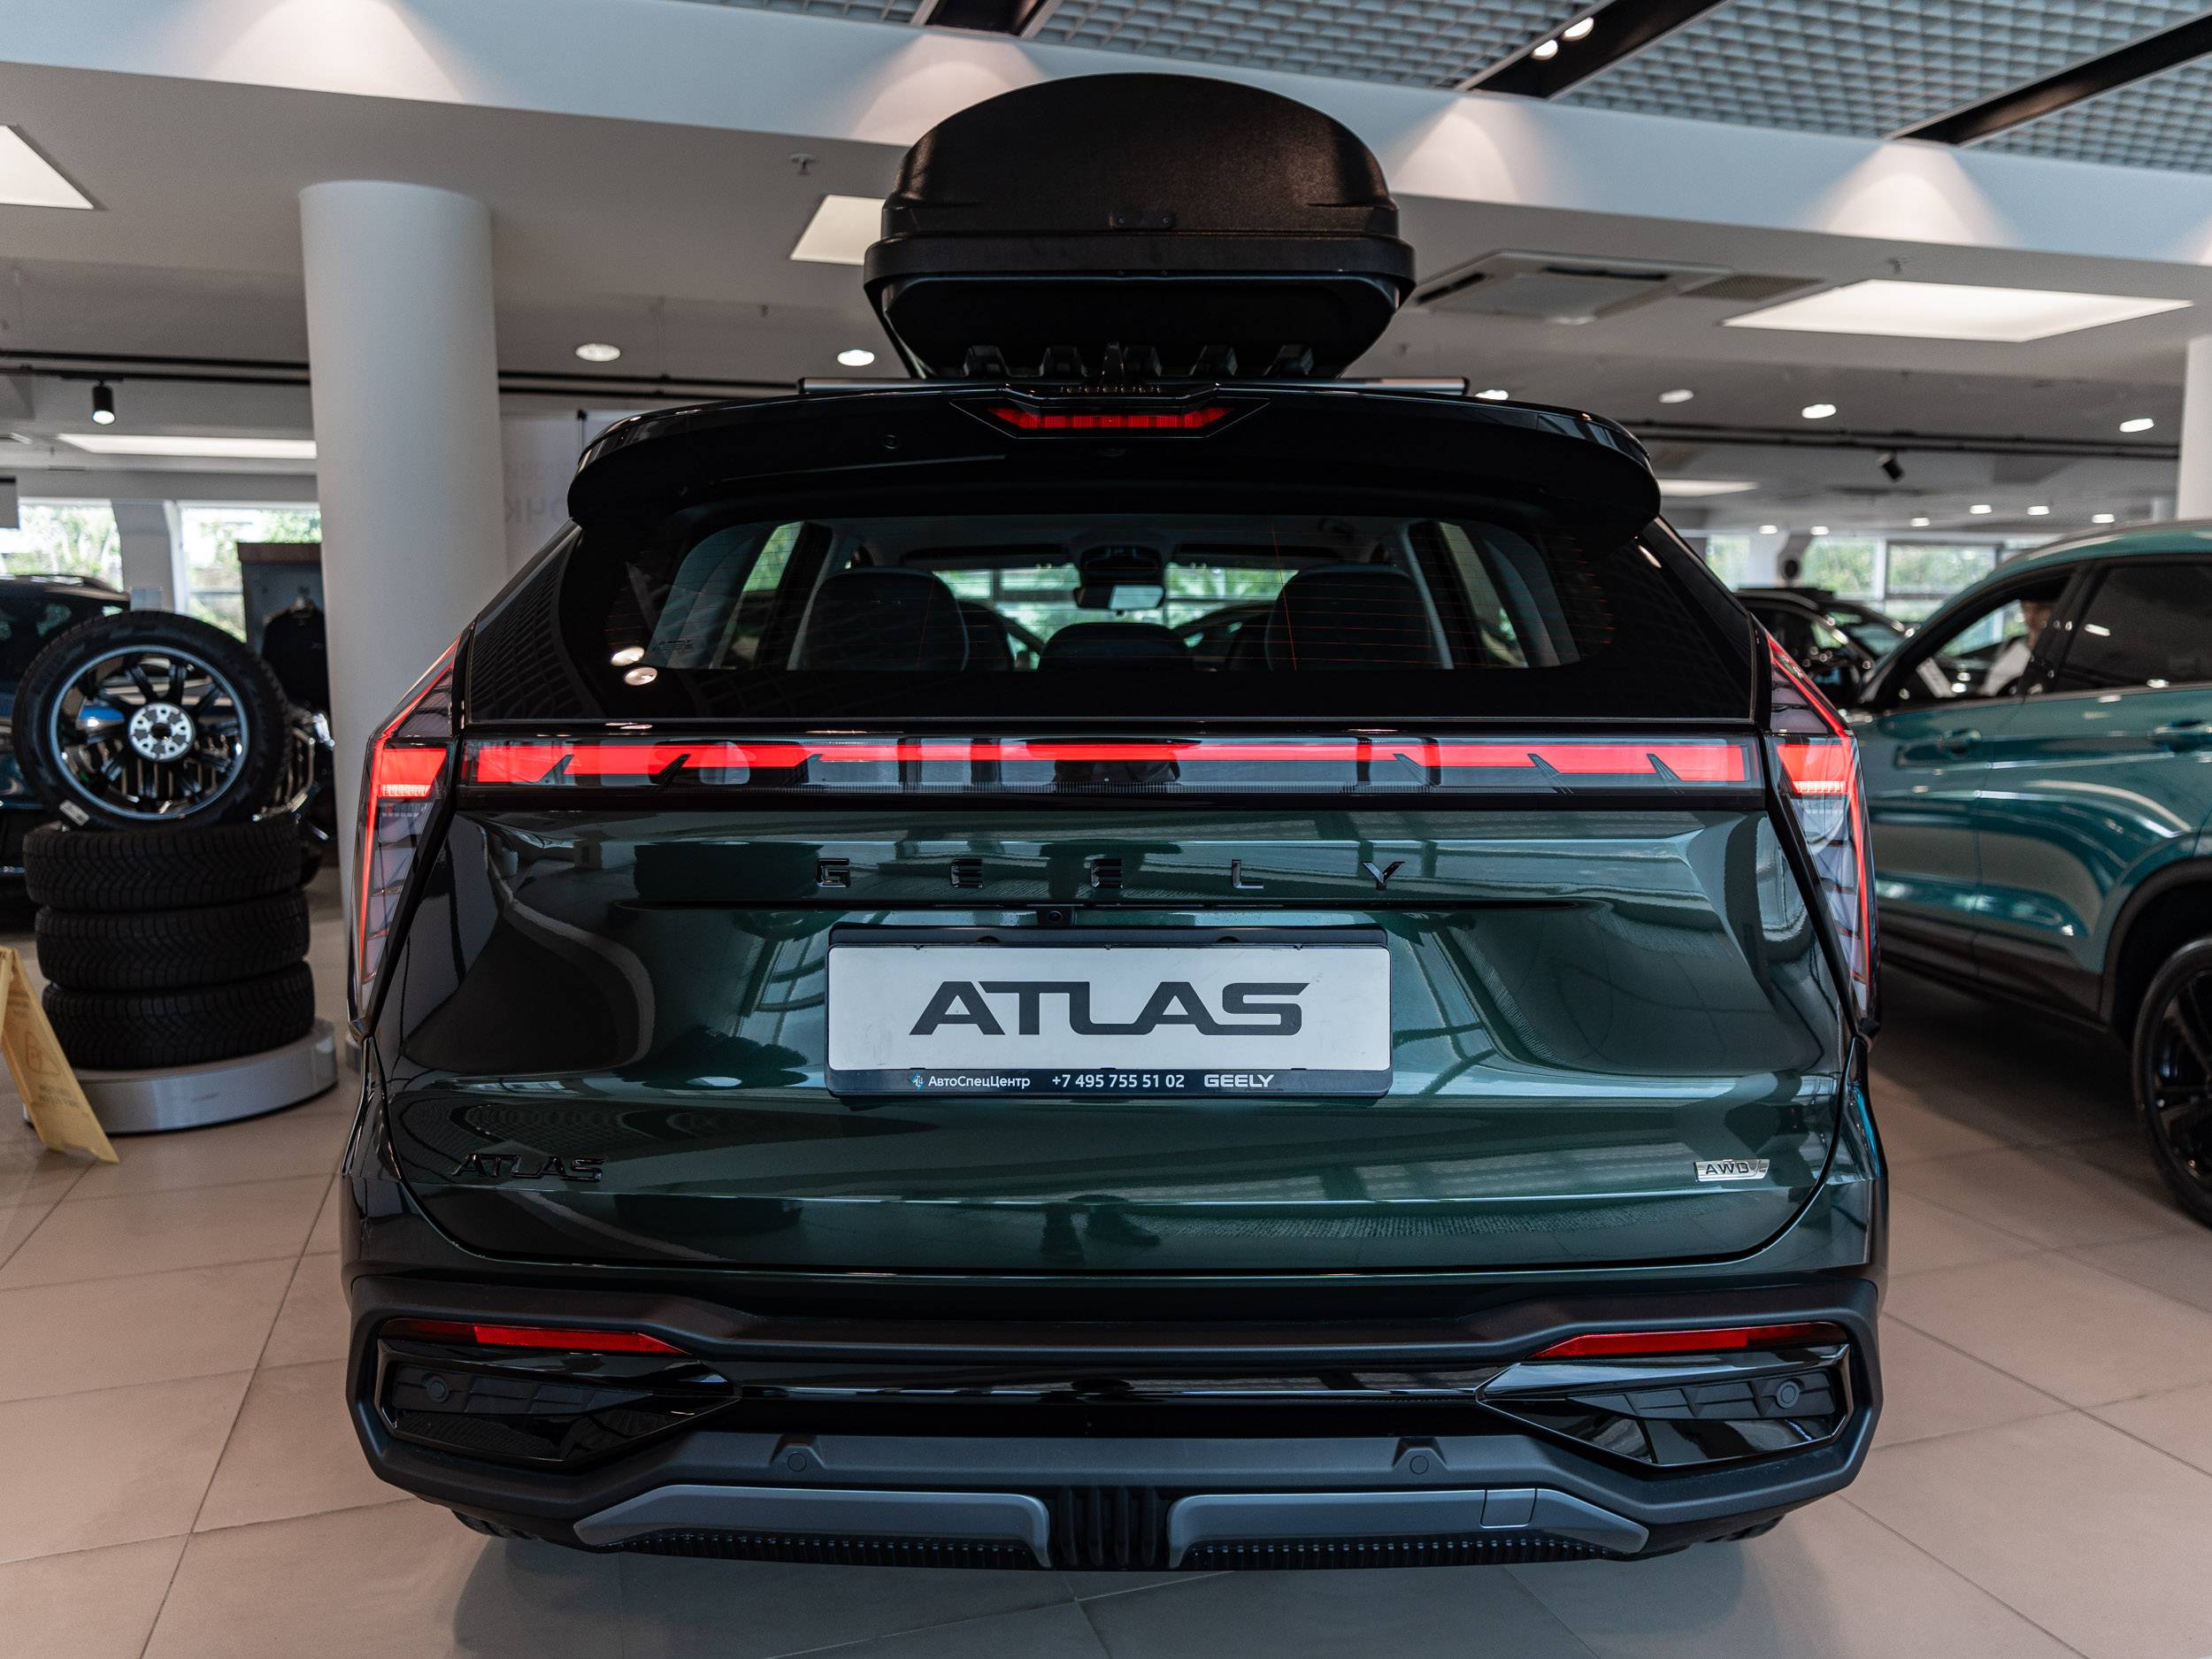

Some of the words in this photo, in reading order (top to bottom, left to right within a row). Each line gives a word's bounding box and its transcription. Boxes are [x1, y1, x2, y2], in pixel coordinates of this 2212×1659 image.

[815, 857, 1405, 890] GEELY
[909, 980, 1310, 1036] ATLAS
[928, 1075, 1031, 1089] АвтоСпецЦентр
[1051, 1074, 1071, 1087] +7
[1075, 1074, 1104, 1087] 495
[1109, 1074, 1138, 1087] 755
[1142, 1074, 1160, 1087] 51
[1165, 1074, 1185, 1087] 02
[1203, 1074, 1275, 1087] GEELY
[450, 1153, 609, 1183] ATLAS
[1705, 1162, 1749, 1175] AWD
